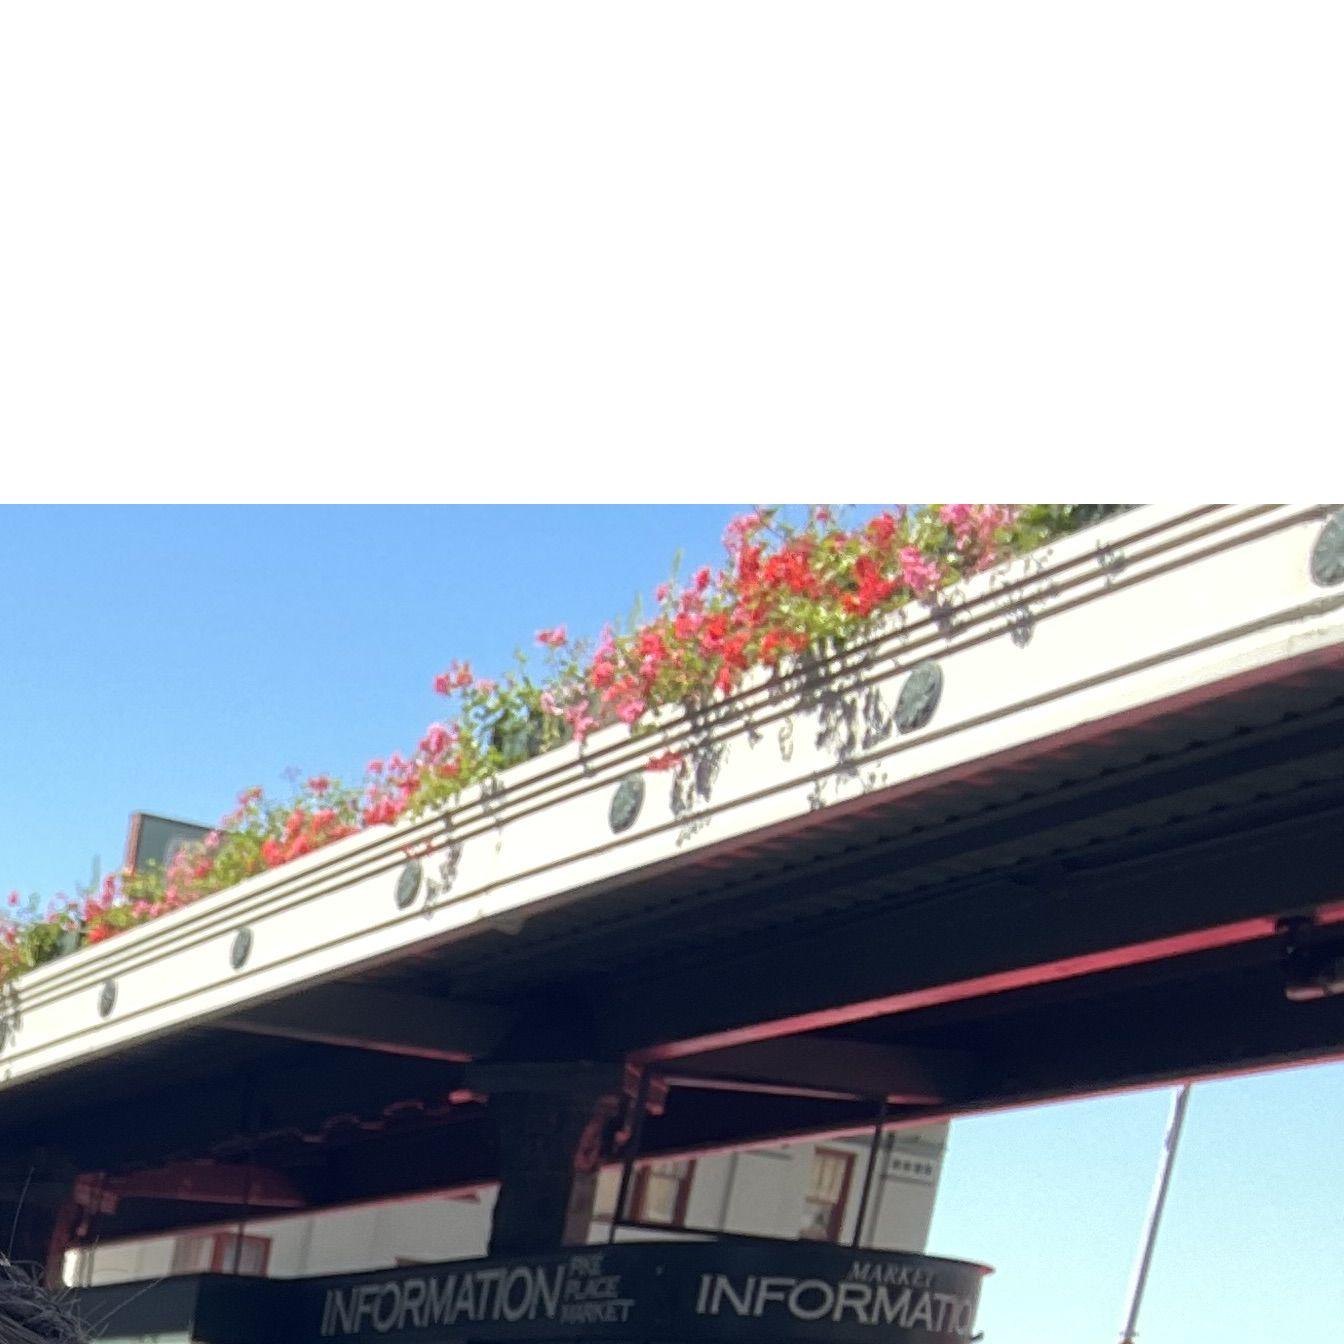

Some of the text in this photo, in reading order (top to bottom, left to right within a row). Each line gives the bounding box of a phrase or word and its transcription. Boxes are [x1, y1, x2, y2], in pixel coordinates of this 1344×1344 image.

[564, 1275, 622, 1300] PLACE
[847, 1261, 936, 1289] MARKET
[320, 1265, 566, 1337] INFORMATION
[562, 1299, 636, 1324] MARKET
